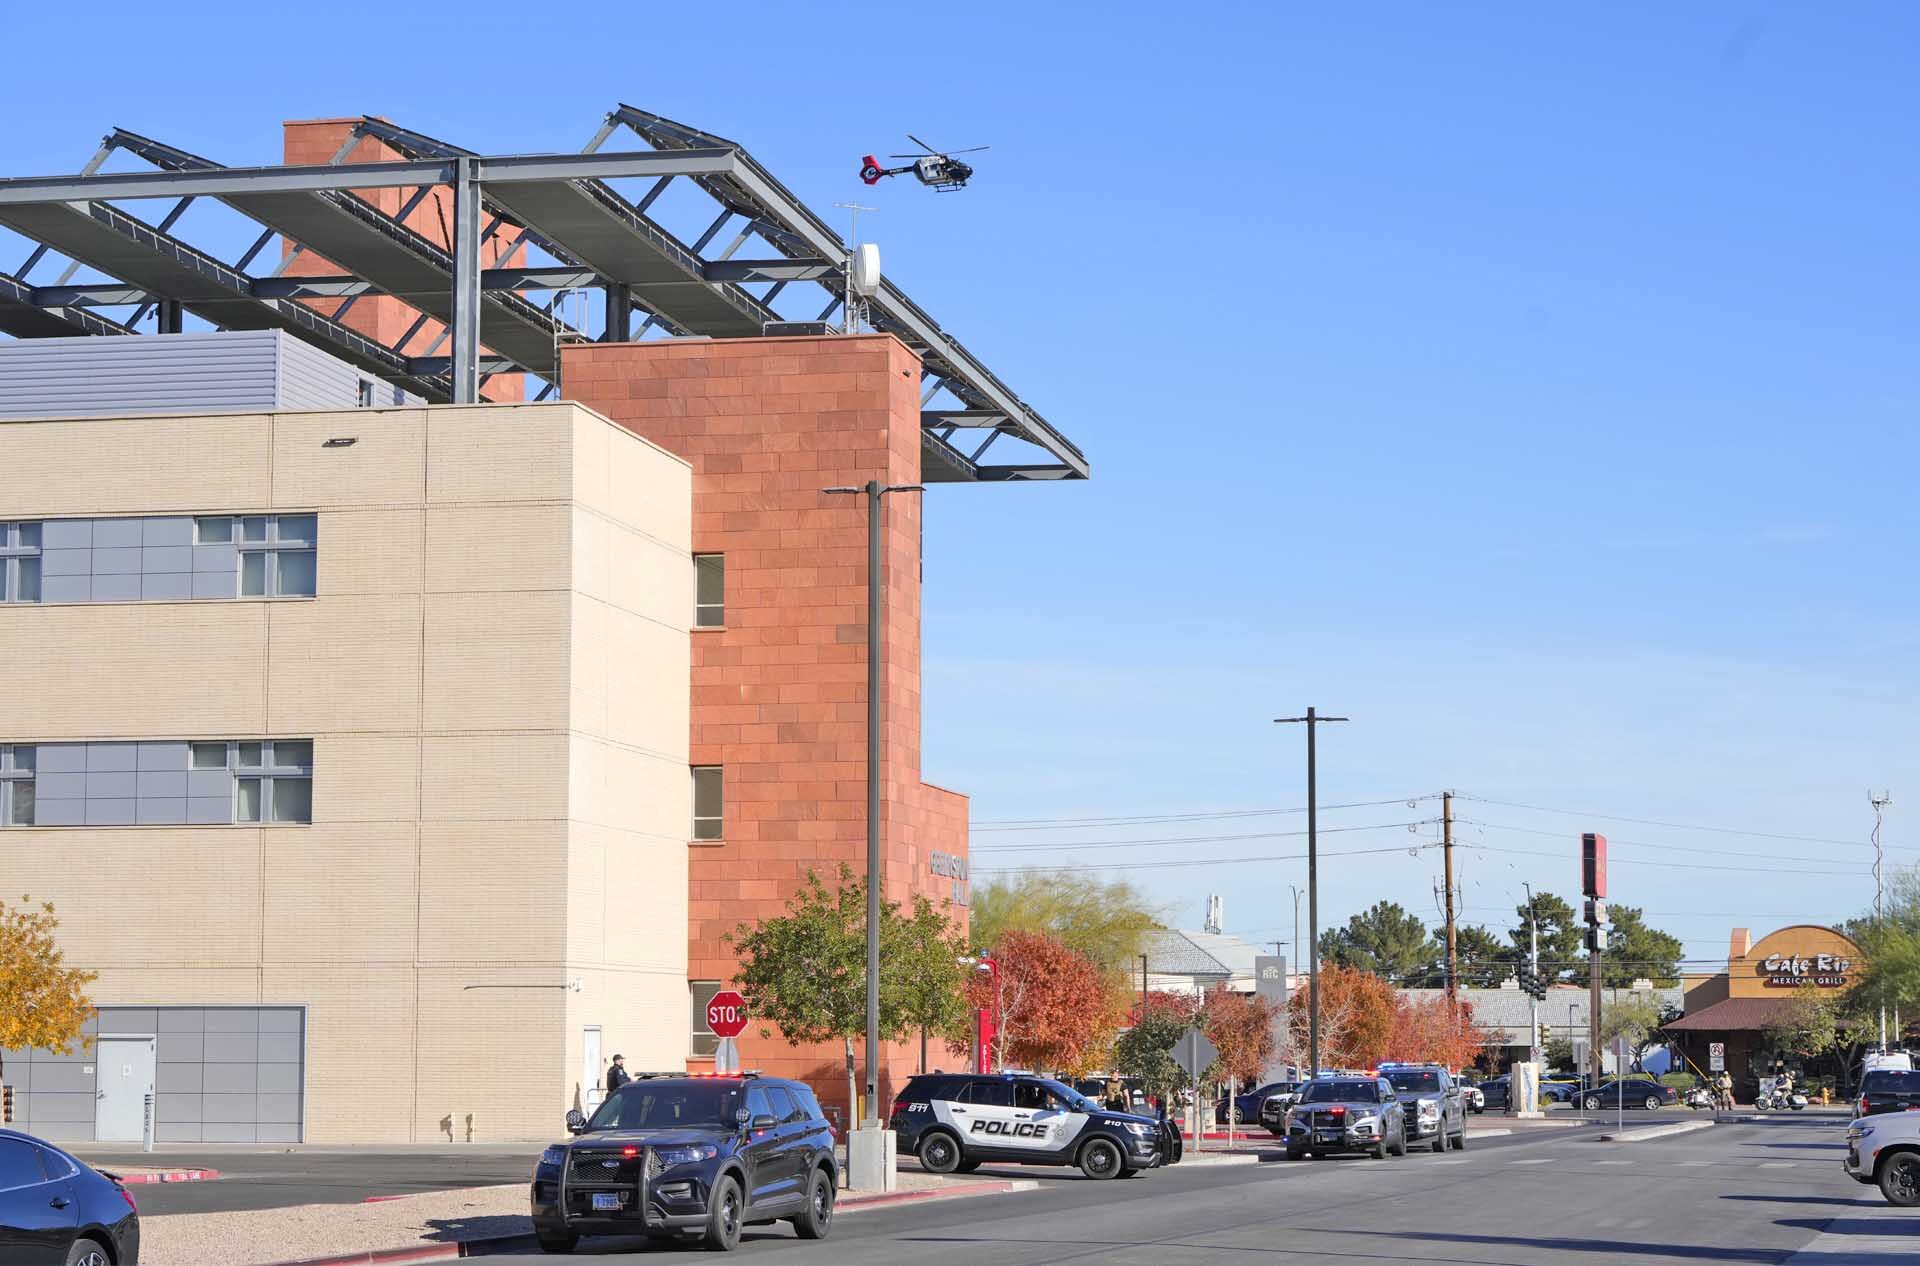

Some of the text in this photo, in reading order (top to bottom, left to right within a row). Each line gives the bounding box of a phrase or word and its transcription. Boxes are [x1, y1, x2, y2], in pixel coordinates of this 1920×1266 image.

[1765, 952, 1849, 976] Cafe Rio
[1263, 969, 1278, 979] RTC
[970, 1119, 1048, 1138] POLICE
